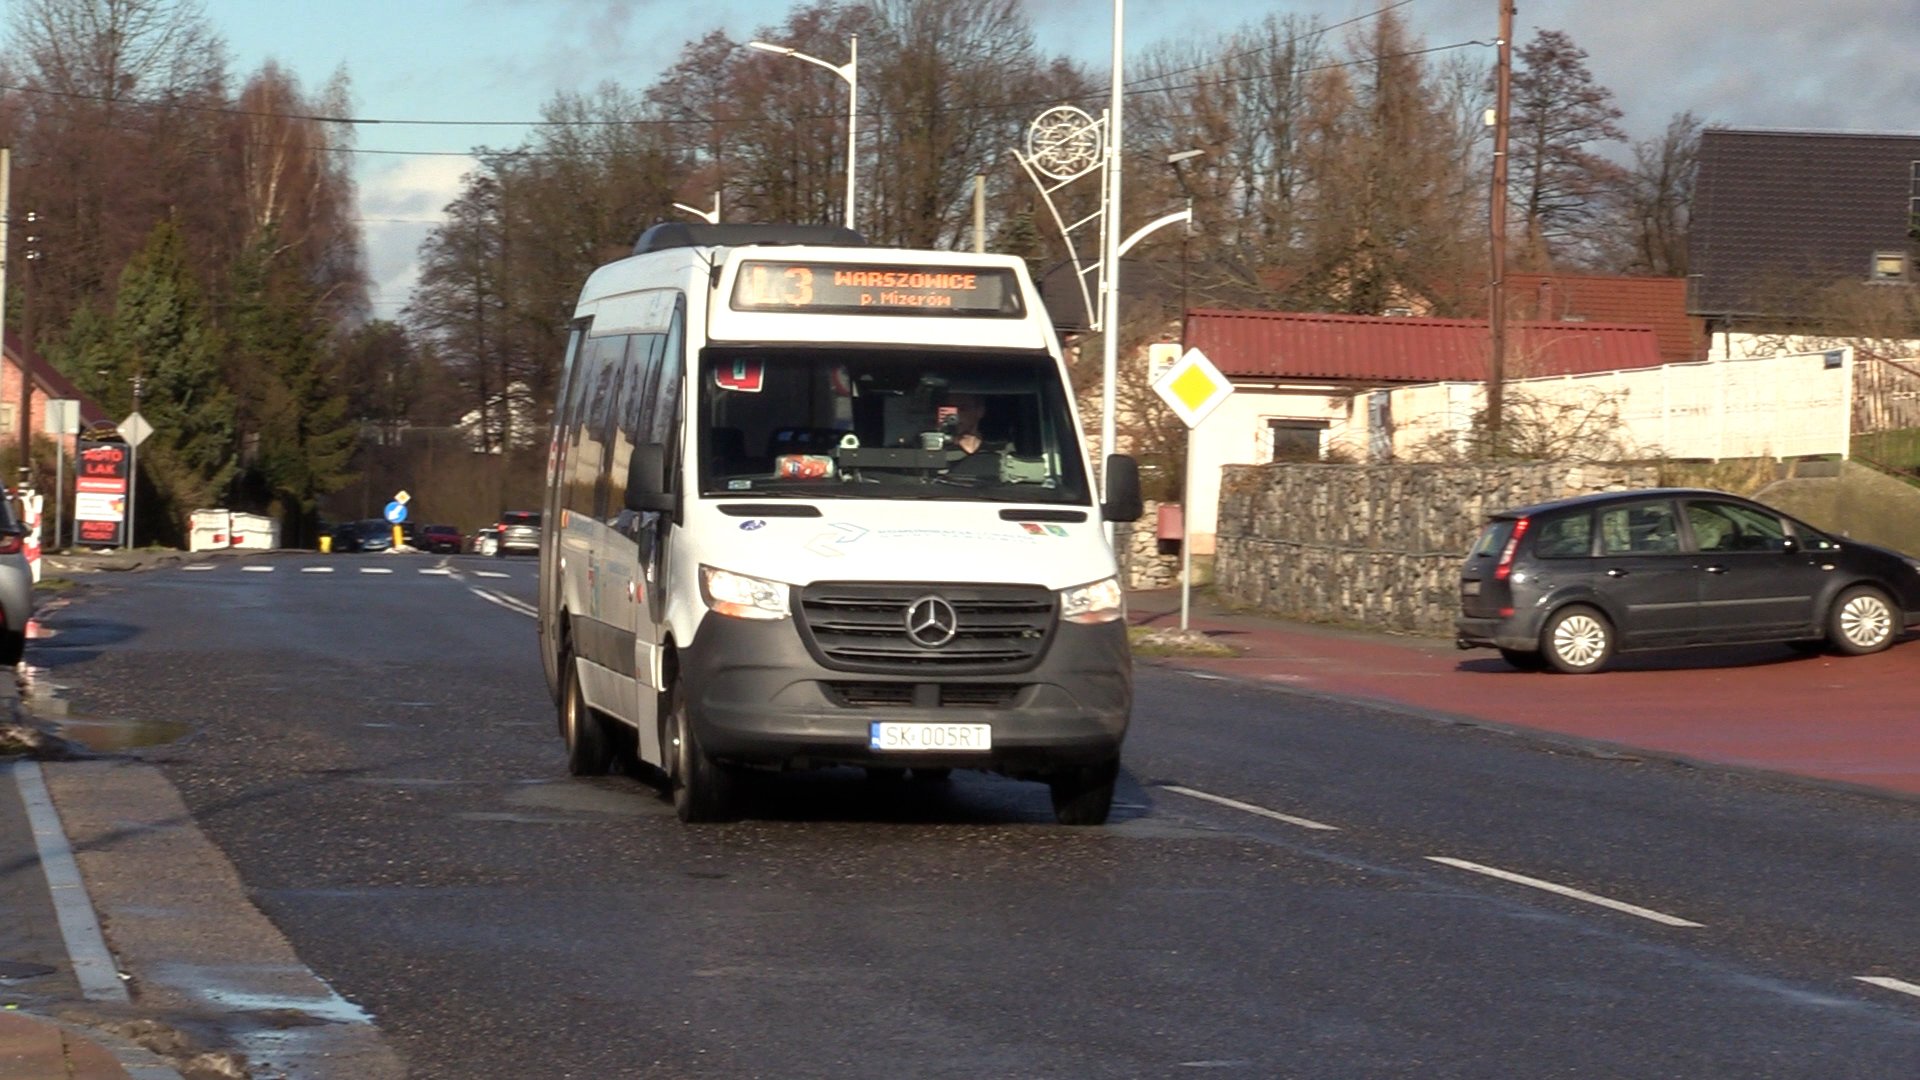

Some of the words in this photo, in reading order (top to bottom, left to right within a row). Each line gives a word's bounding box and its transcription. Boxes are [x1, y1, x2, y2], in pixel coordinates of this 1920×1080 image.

[834, 271, 977, 290] WARSZOWICE
[861, 293, 877, 306] p.
[881, 290, 951, 306] Mizerów
[86, 463, 116, 474] LAK
[886, 726, 912, 746] SK
[921, 726, 985, 747] 005RT
